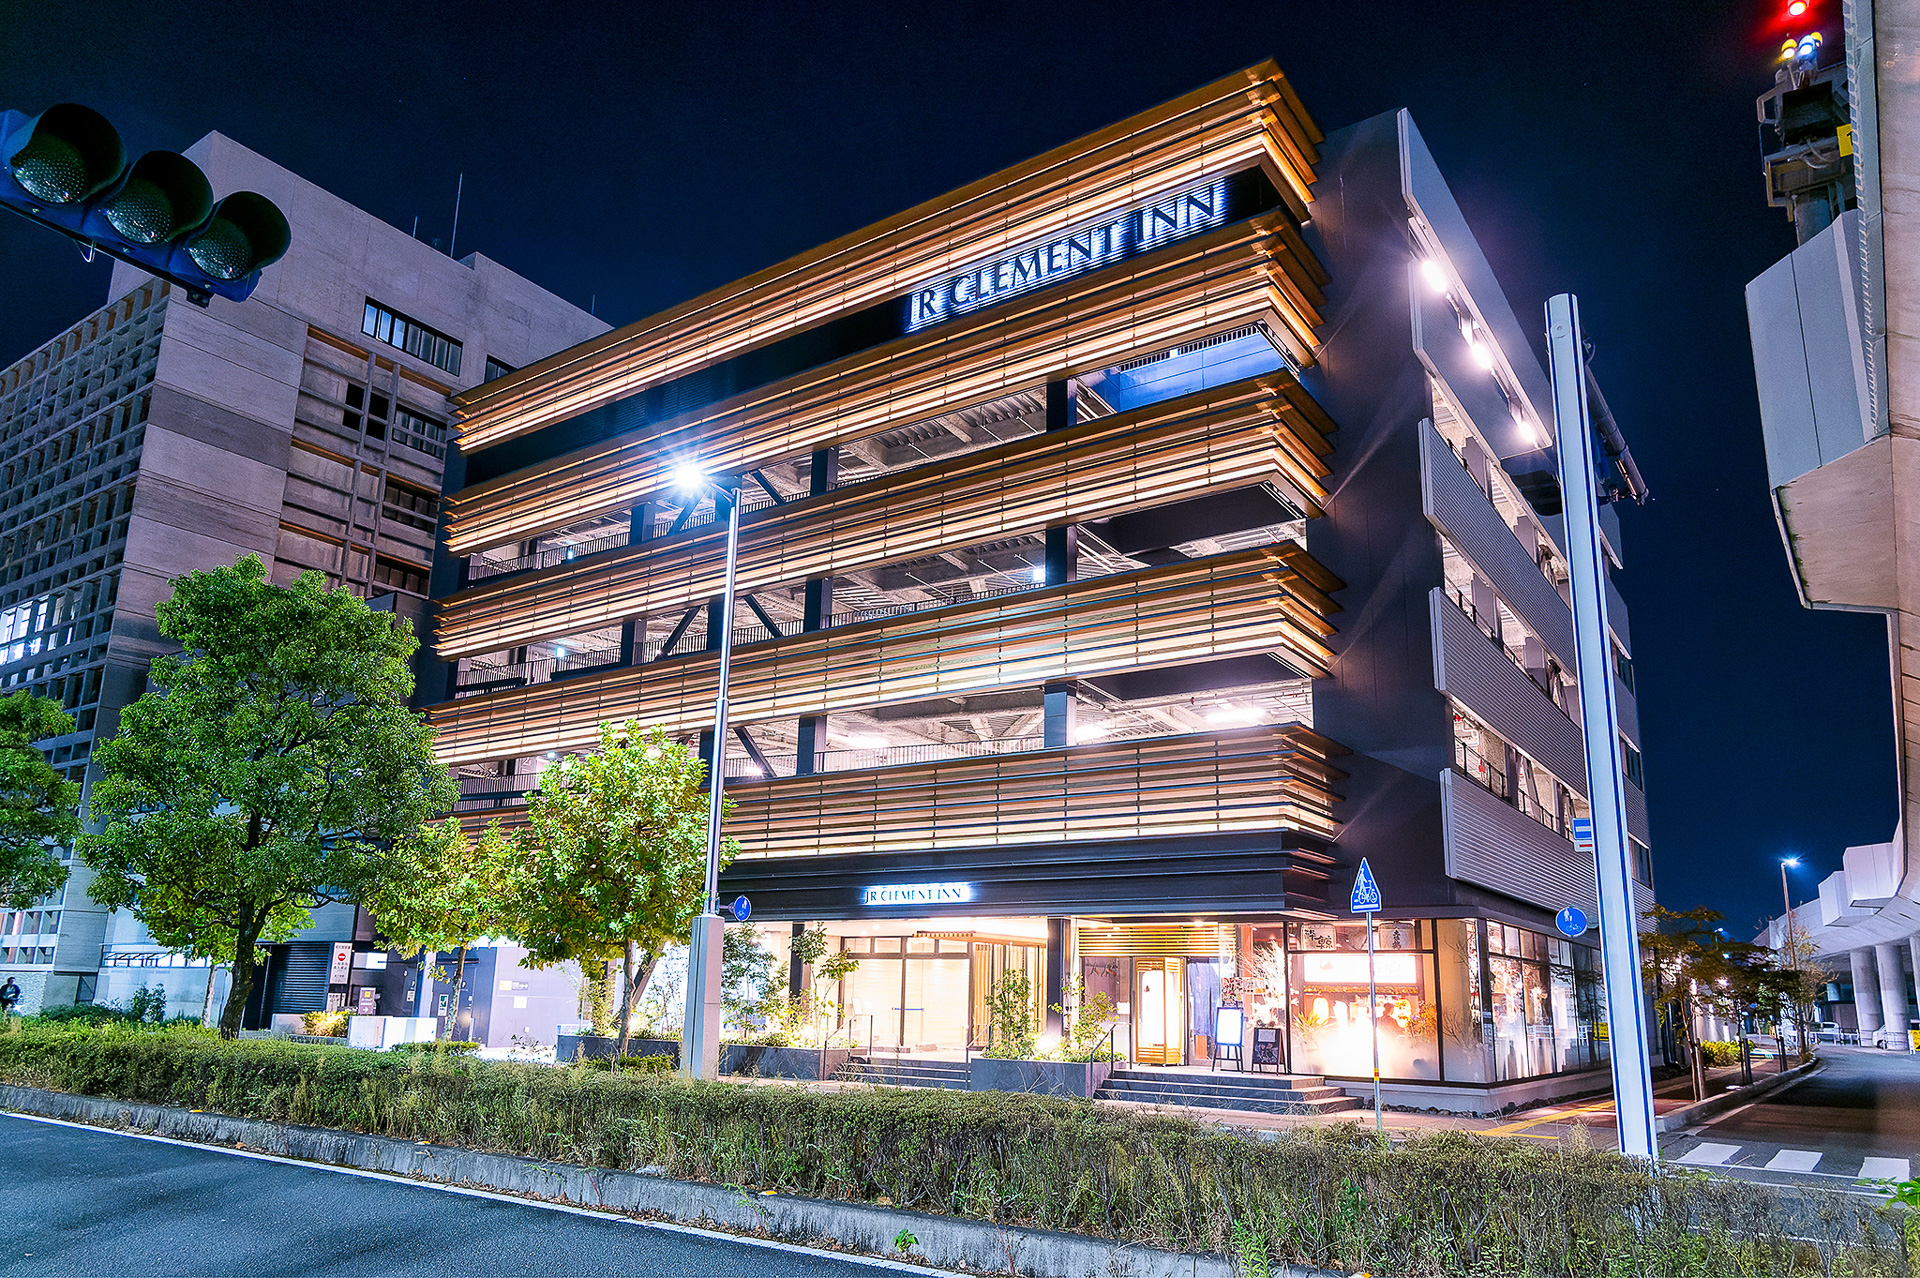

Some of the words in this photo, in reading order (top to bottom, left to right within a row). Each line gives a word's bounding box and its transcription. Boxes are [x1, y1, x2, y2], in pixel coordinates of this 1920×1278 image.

[904, 287, 938, 332] JR
[950, 221, 1119, 307] CLEMENT
[1135, 184, 1217, 245] INN
[864, 890, 877, 904] JR
[880, 888, 933, 902] CLEMENT
[937, 888, 962, 900] INN
